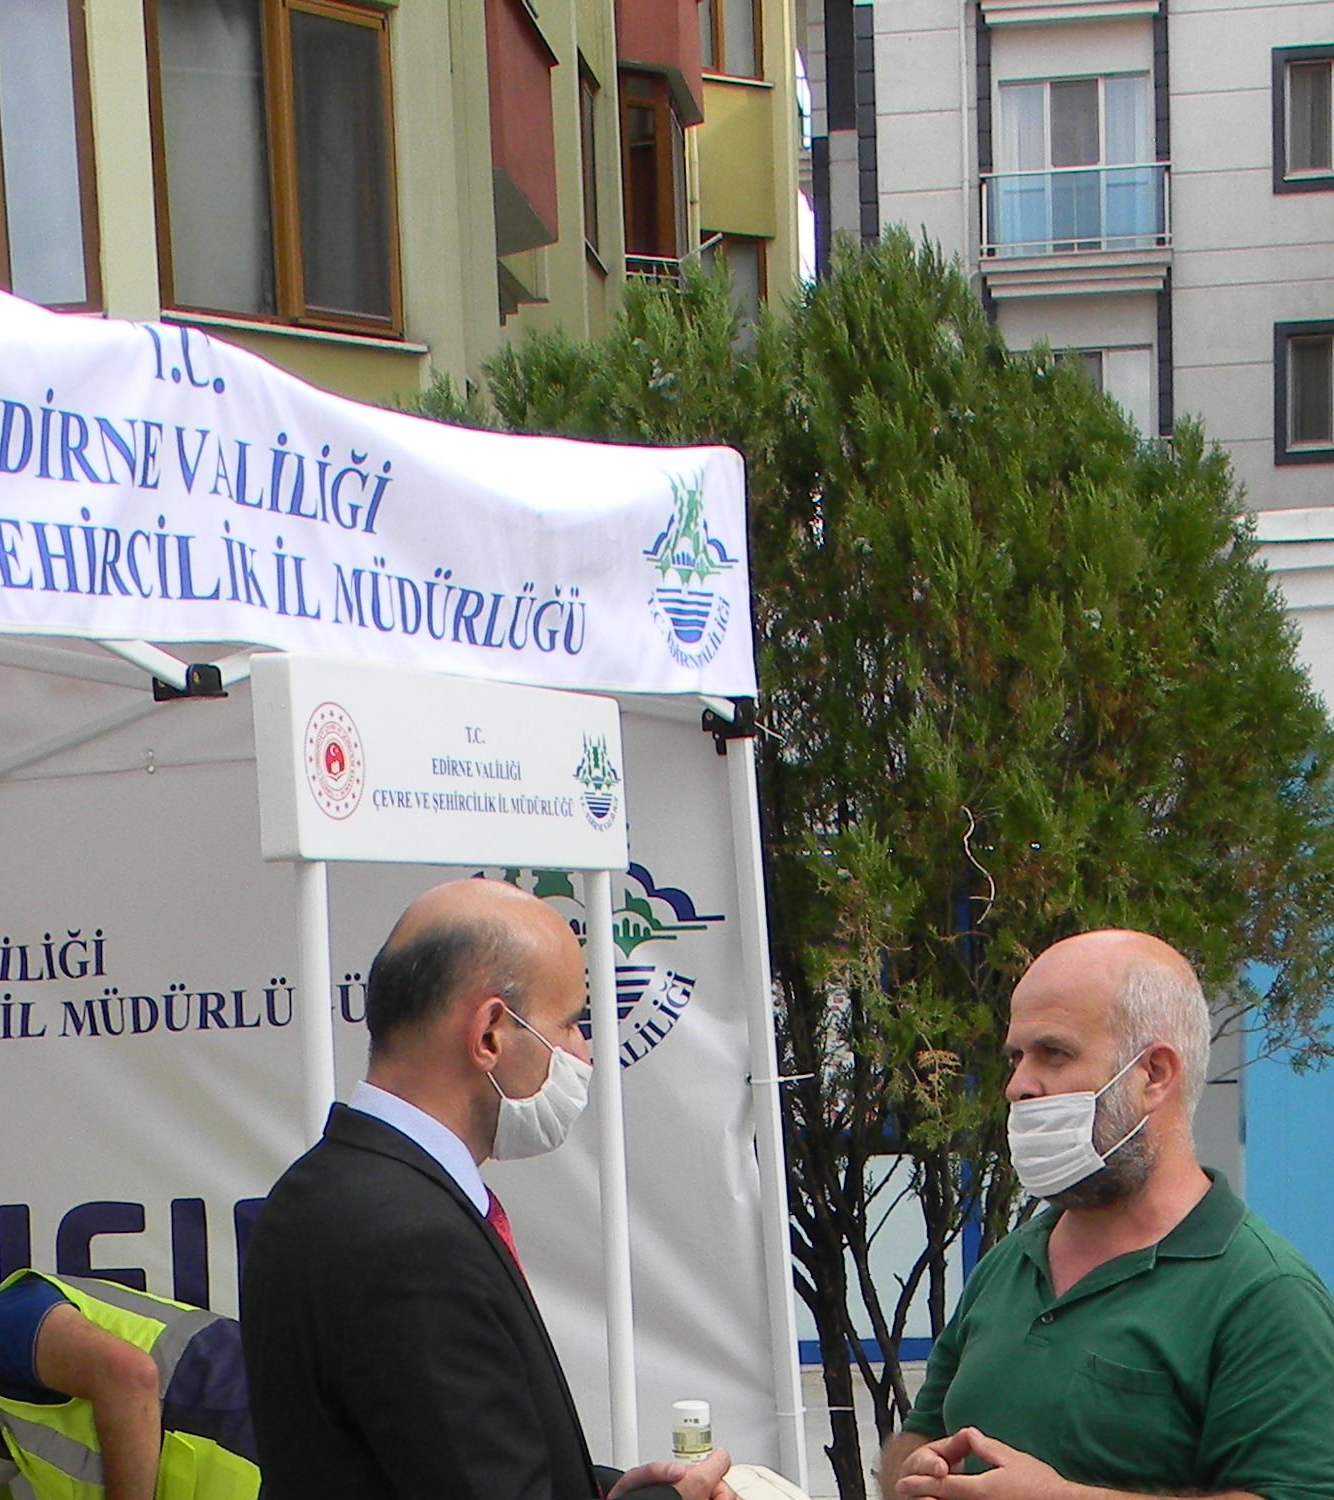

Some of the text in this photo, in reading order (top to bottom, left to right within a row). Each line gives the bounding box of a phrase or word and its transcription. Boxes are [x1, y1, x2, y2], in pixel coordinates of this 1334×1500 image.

[174, 425, 394, 535] VALİLİĞİ
[270, 535, 323, 622] İL
[331, 556, 586, 656] MÜDÜRLÜĞÜ
[431, 756, 522, 781] EDİRNE VALİLİĞİ
[465, 726, 485, 744] T.C.
[373, 789, 412, 811] ÇEVRE
[414, 791, 431, 810] VE
[432, 790, 497, 814] ŞEHİRCİLİK
[498, 793, 509, 813] İL
[511, 794, 574, 817] MÜDÜRLÜĞÜ
[0, 993, 47, 1040] İL
[58, 972, 368, 1038] MÜDÜRLÜÜ
[619, 970, 697, 1070] LİLİĞİ
